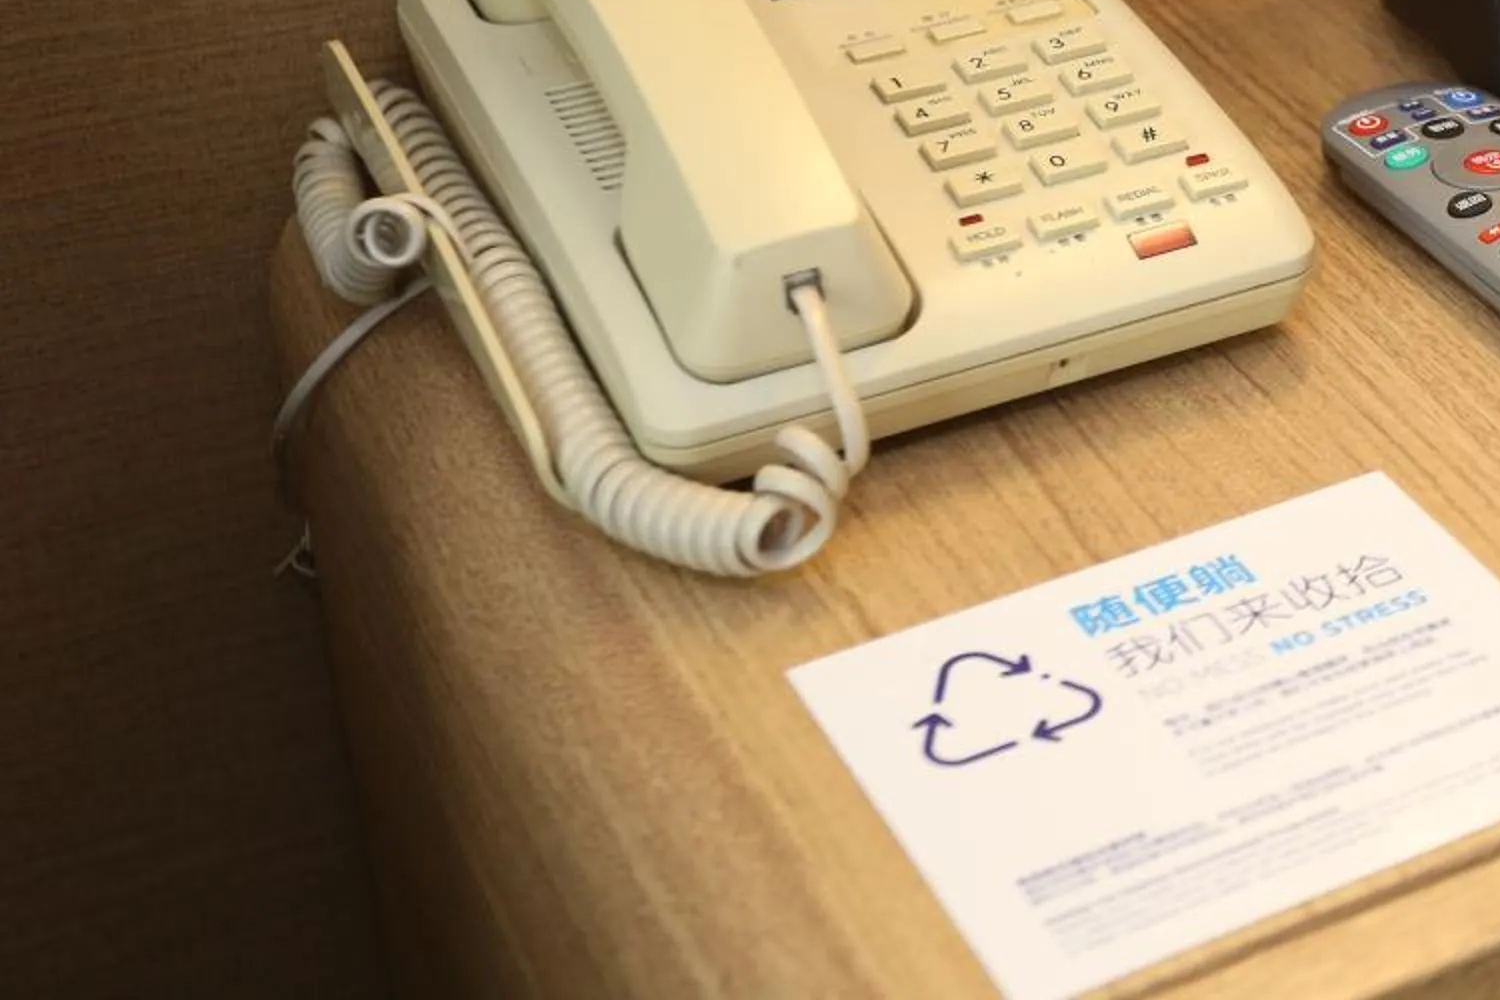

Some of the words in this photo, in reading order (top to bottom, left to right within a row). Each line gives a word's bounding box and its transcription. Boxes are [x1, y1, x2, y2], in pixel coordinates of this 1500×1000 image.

[1049, 37, 1064, 49] 3
[968, 57, 988, 69] 2
[1078, 67, 1092, 80] 6
[891, 76, 903, 89] 1
[997, 87, 1012, 100] 5
[916, 107, 929, 118] 4
[1104, 101, 1119, 113] 9
[1018, 119, 1035, 132] 8
[935, 139, 949, 152] 7
[1069, 554, 1258, 637] 随便躺
[1106, 555, 1403, 678] 我们来收拾
[1269, 630, 1316, 655] NO
[1321, 589, 1429, 637] STRESS
